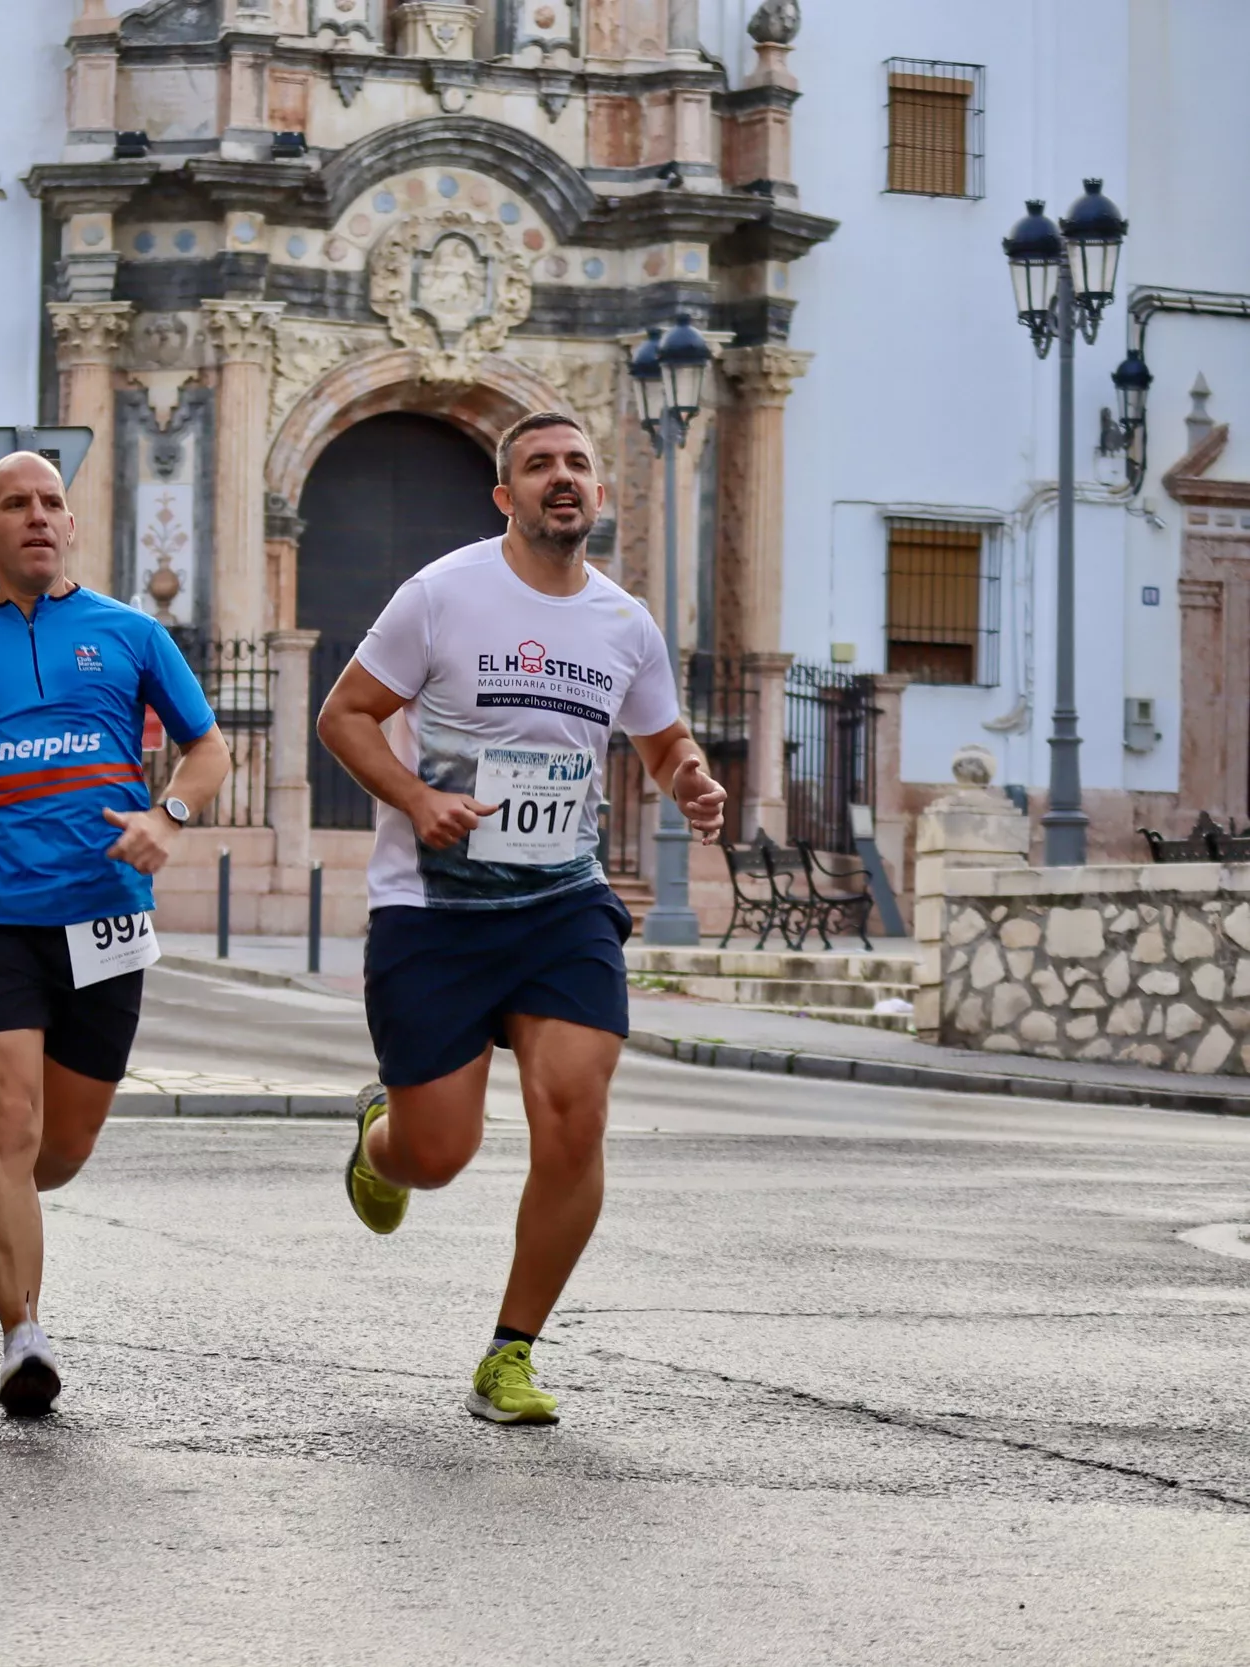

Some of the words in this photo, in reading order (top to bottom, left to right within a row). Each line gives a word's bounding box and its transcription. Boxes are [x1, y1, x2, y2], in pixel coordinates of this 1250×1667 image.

[478, 654, 500, 672] EL
[477, 679, 546, 690] MAQUINARIA
[550, 684, 562, 693] DE
[492, 695, 603, 721] www.elhostelero.com
[498, 798, 577, 834] 1017
